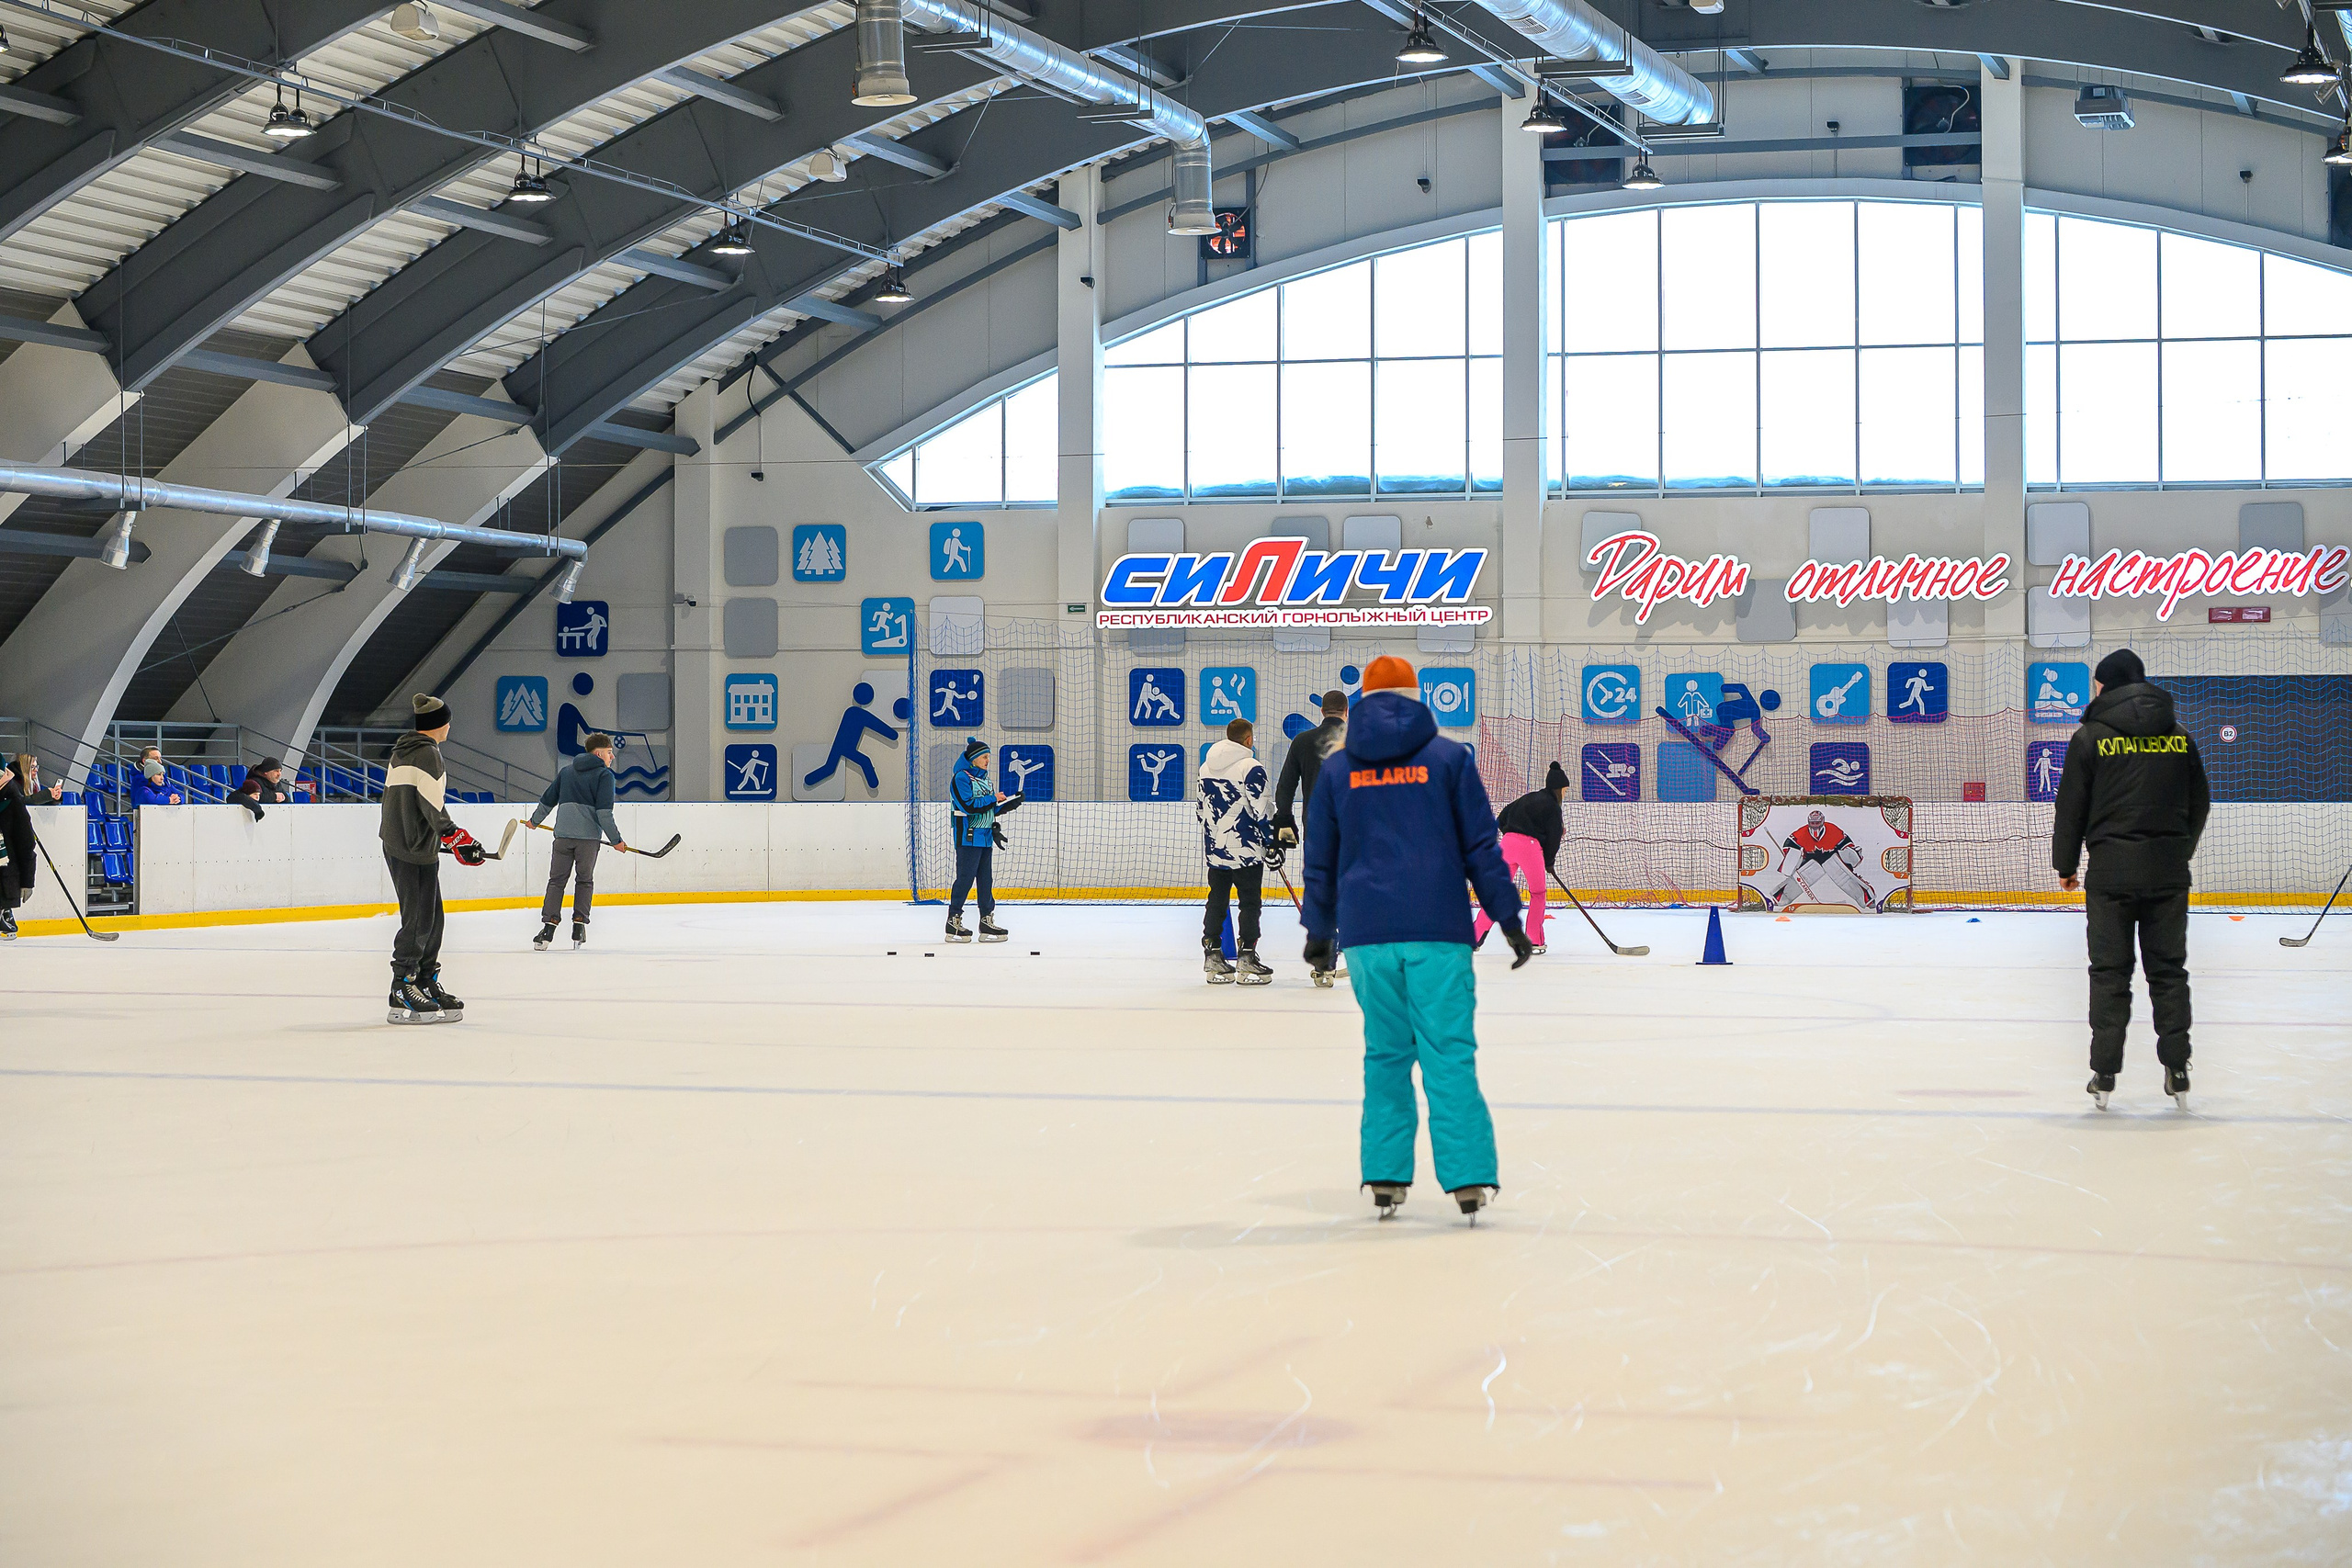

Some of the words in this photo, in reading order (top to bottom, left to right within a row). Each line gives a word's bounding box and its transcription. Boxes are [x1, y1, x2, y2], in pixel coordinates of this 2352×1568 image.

[1589, 532, 1747, 623] Дарим
[1786, 555, 2007, 605] отличное
[2050, 547, 2347, 619] настроение
[1099, 608, 1278, 626] РЕСПУБЛИКАНСКИЙ
[1282, 608, 1427, 625] ГОРНОЛЫЖНЫЙ
[1430, 608, 1489, 624] ЦЕНТР
[1614, 687, 1637, 703] 24
[1350, 765, 1429, 789] BELARUS
